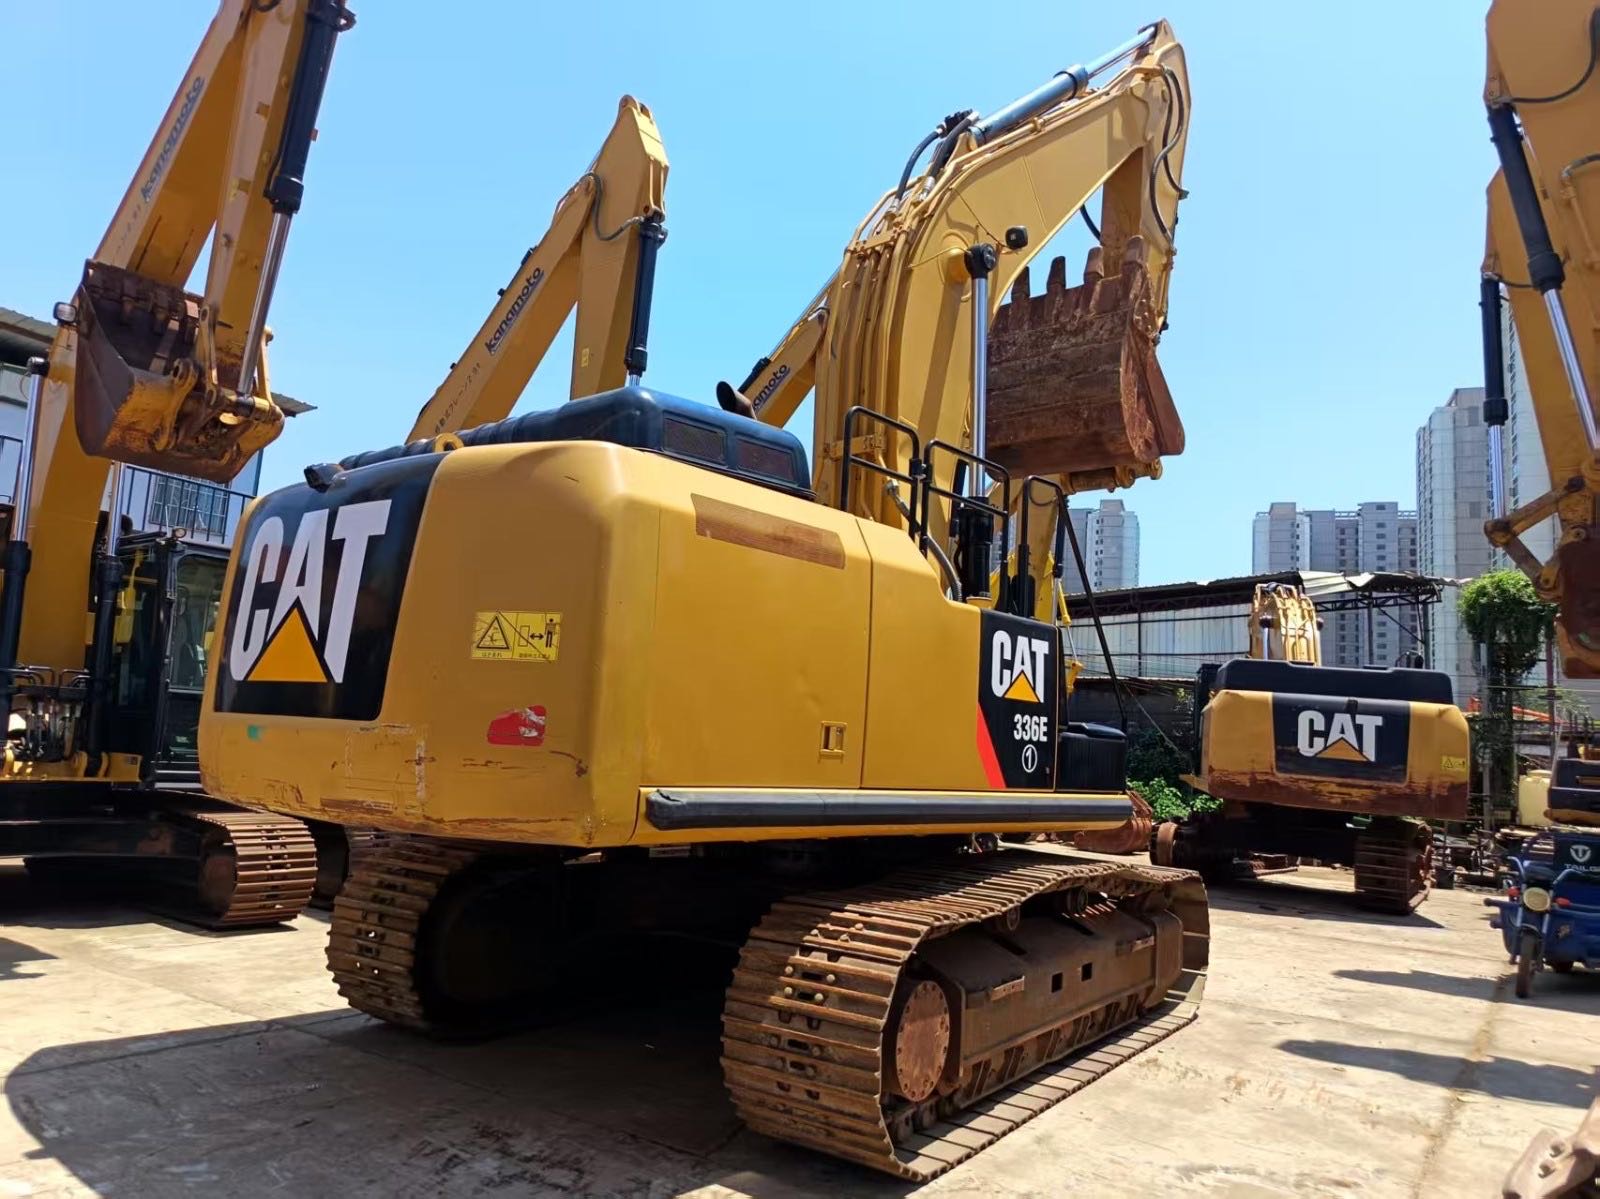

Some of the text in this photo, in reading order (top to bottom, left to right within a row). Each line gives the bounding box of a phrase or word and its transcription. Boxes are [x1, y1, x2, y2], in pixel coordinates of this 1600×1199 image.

[485, 267, 542, 352] kanamoto
[752, 365, 788, 410] amoto
[230, 499, 392, 684] CAT
[991, 630, 1049, 704] CAT
[1013, 713, 1048, 742] 336E
[1297, 710, 1383, 762] CAT
